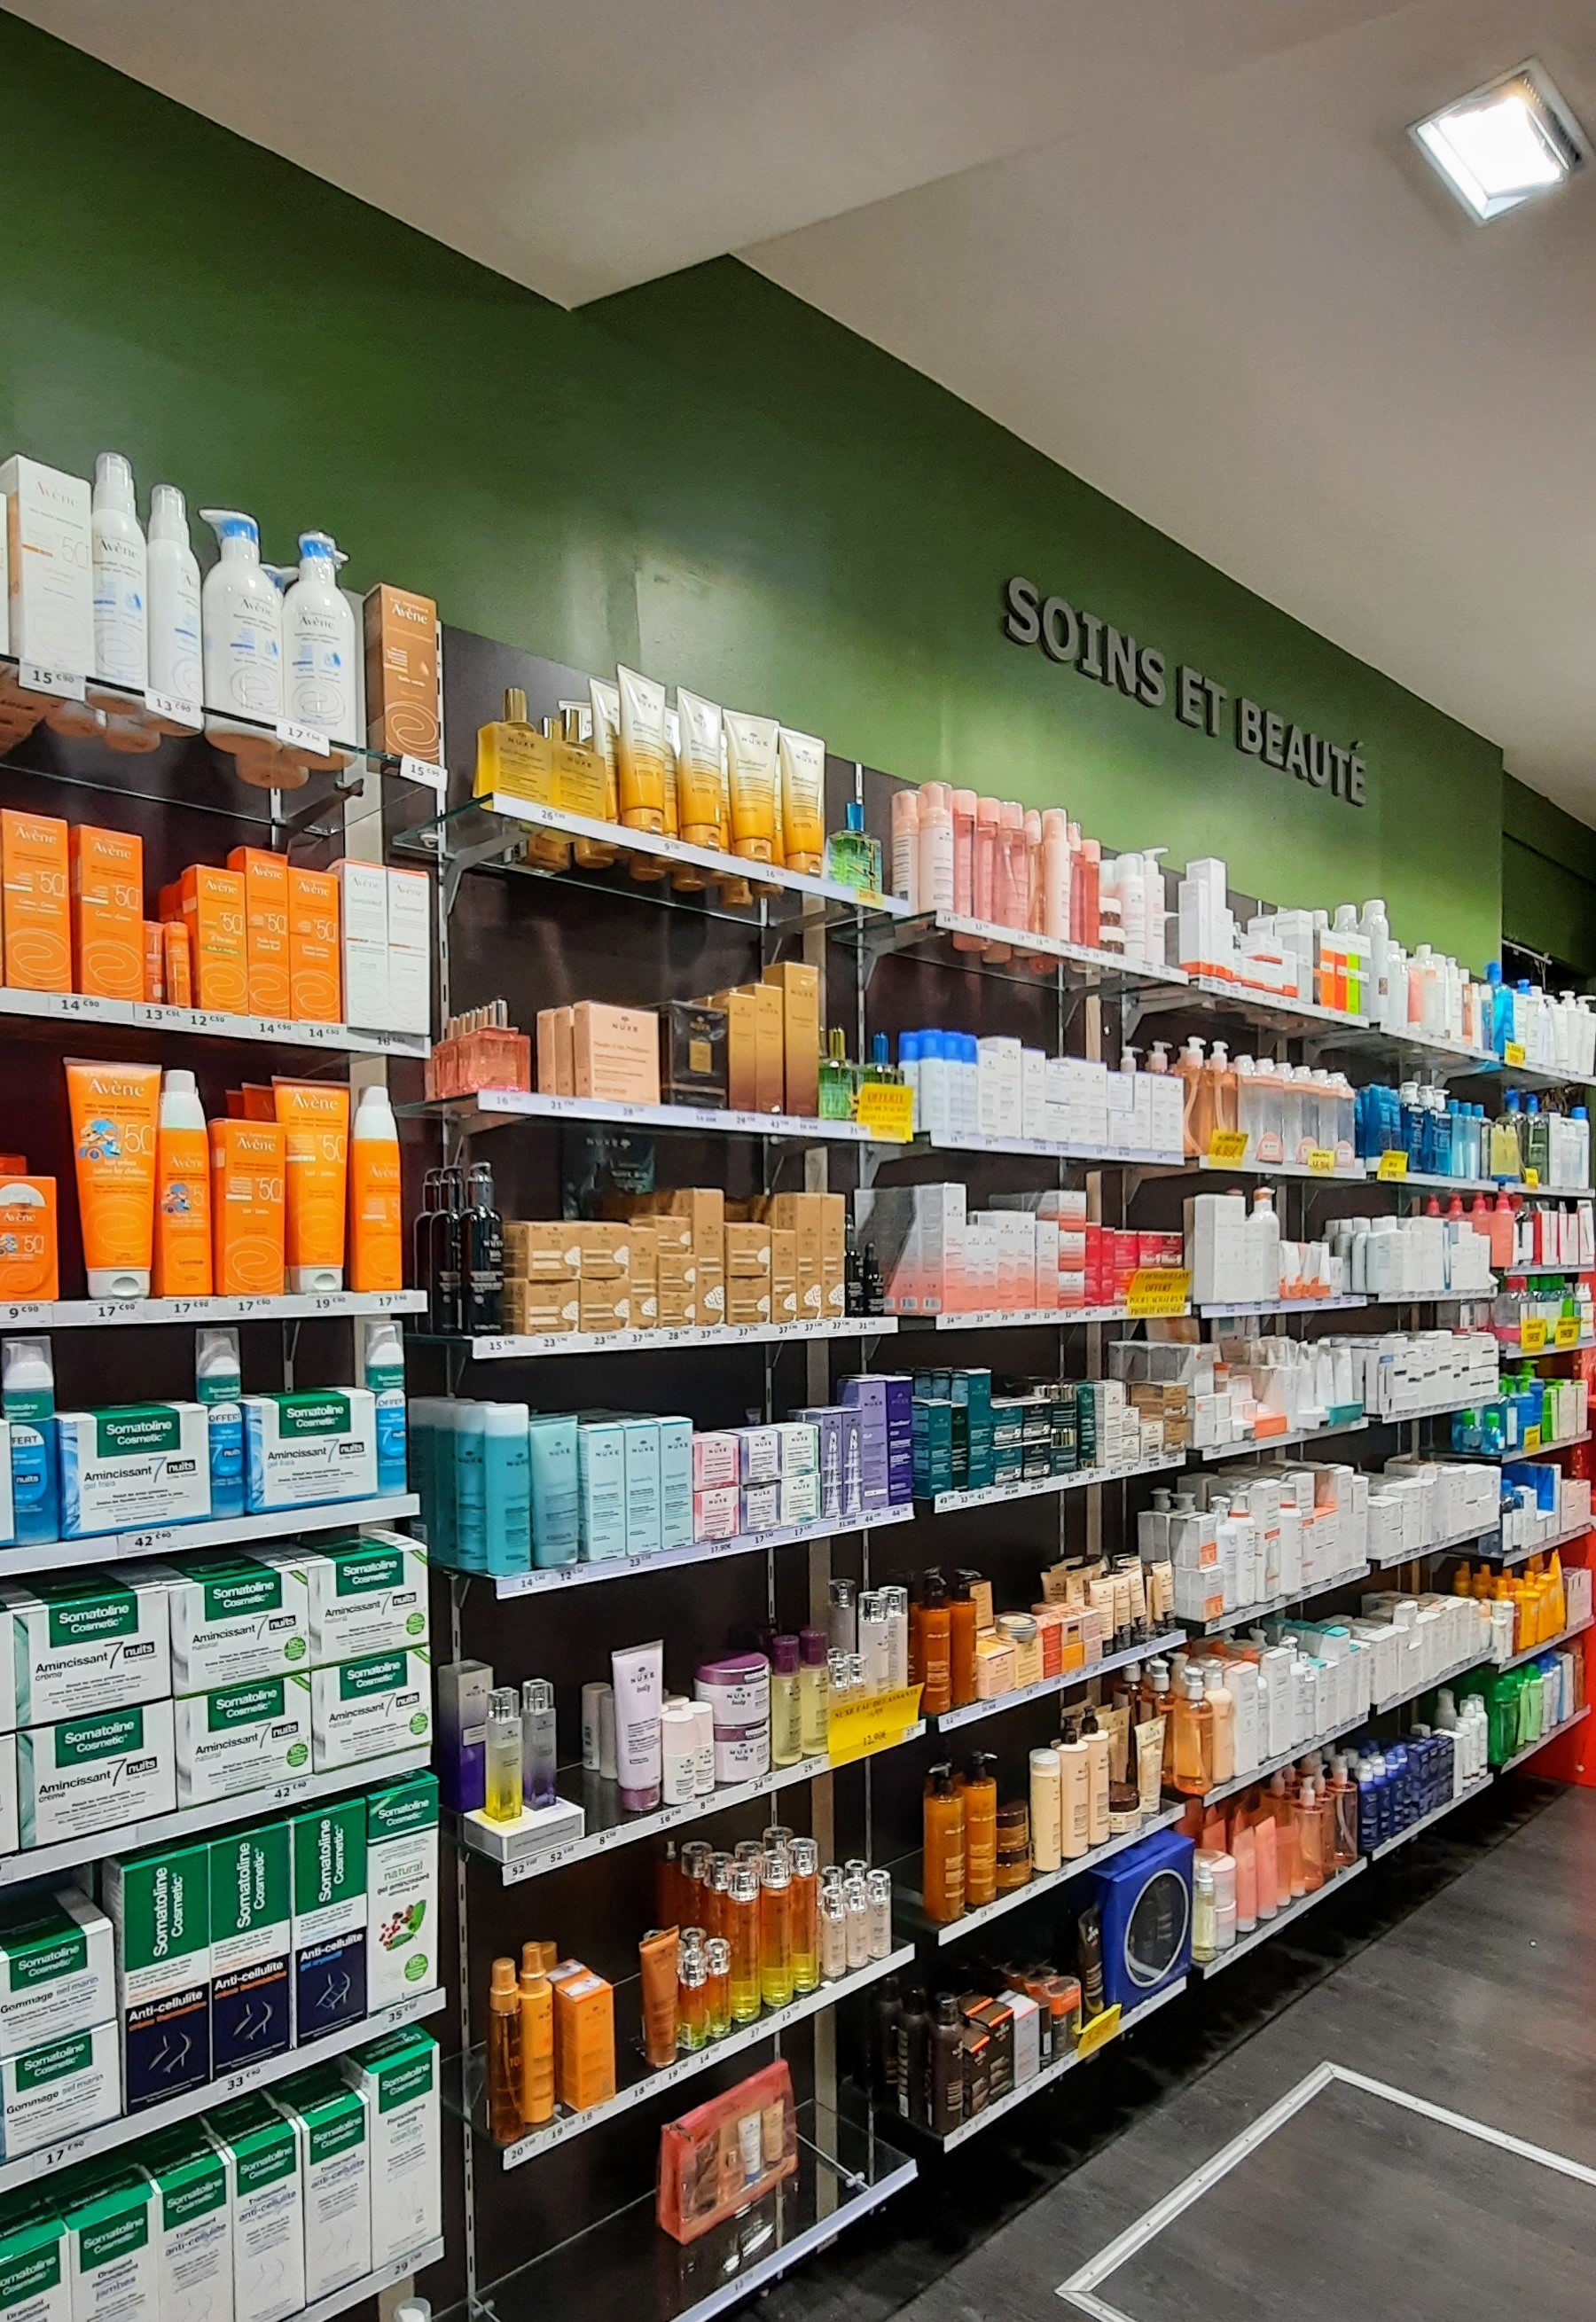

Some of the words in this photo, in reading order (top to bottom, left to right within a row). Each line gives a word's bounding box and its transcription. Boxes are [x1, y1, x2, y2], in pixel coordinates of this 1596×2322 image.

[35, 481, 79, 507] Avène
[99, 539, 138, 560] Avène
[241, 598, 273, 617] Avène
[392, 603, 427, 624] Avène
[300, 616, 334, 629] Avène
[33, 670, 52, 684] 15
[1003, 575, 1167, 708] SOINS
[1176, 666, 1227, 737] ET
[1237, 697, 1366, 807] BEAUTÉ
[156, 699, 172, 711] 13
[288, 727, 302, 739] 17
[508, 736, 535, 749] NUXE
[741, 736, 769, 747] NUXE
[567, 755, 592, 769] NUXE
[795, 754, 818, 766] NUXE
[411, 764, 424, 777] 15
[542, 810, 552, 820] 26
[16, 826, 57, 844] Avène
[95, 842, 131, 860] Avène
[253, 864, 283, 880] Avène
[206, 879, 238, 895] Avène
[298, 880, 330, 897] Avène
[62, 1000, 80, 1011] 14
[146, 1010, 162, 1020] 13
[192, 1015, 207, 1026] 12
[260, 1023, 274, 1033] 14
[309, 1028, 324, 1038] 14
[613, 1023, 638, 1033] NUXE
[89, 1077, 145, 1098] Avène
[293, 1092, 339, 1110] Avène
[238, 1138, 276, 1152] Avène
[172, 1156, 203, 1169] Avène
[4, 1211, 35, 1223] Avène
[174, 1303, 190, 1314] 17
[239, 1302, 253, 1310] 17
[317, 1299, 330, 1309] 19
[379, 1297, 392, 1306] 17
[9, 1307, 18, 1318] 9
[98, 1307, 115, 1317] 17
[544, 1339, 555, 1348] 23
[594, 1336, 605, 1345] 23
[286, 1405, 344, 1419] Somatoline
[106, 1420, 172, 1435] Somatoline
[295, 1417, 336, 1428] Cosmetic
[117, 1434, 163, 1446] Cosmetic
[268, 1447, 326, 1460] Amincissant
[323, 1439, 340, 1463] 7
[340, 1442, 364, 1453] nuits
[549, 1447, 571, 1456] NUXE
[595, 1449, 619, 1458] NUXE
[84, 1466, 152, 1482] Amincissant
[148, 1457, 168, 1483] 7
[168, 1460, 195, 1474] nuits
[135, 1537, 153, 1546] 42
[343, 1560, 397, 1576] Somatoline
[351, 1572, 390, 1585] Cosmetic
[560, 1572, 571, 1581] 12
[213, 1580, 275, 1599] Somatoline
[223, 1594, 266, 1608] Cosmetic
[325, 1601, 381, 1618] Amincissant
[378, 1591, 392, 1615] 7
[393, 1592, 416, 1605] nuits
[59, 1605, 129, 1624] Somatoline
[71, 1619, 120, 1633] Cosmetic
[192, 1624, 255, 1644] Amincissant
[252, 1614, 270, 1640] 7
[270, 1616, 295, 1630] nuits
[35, 1653, 108, 1674] Amincissant
[105, 1642, 124, 1669] 7
[124, 1643, 153, 1657] nuits
[347, 1661, 401, 1680] Somatoline
[630, 1671, 654, 1684] NUXE
[356, 1673, 393, 1687] Cosmetic
[216, 1688, 277, 1709] Somatoline
[226, 1702, 269, 1718] Cosmetic
[329, 1704, 385, 1723] Amincissant
[381, 1693, 396, 1717] 7
[396, 1693, 419, 1707] nuits
[856, 1704, 869, 1713] EAU
[65, 1722, 135, 1745] Somatoline
[195, 1732, 258, 1755] Amincissant
[255, 1723, 271, 1748] 7
[272, 1722, 298, 1738] nuits
[76, 1735, 124, 1754] Cosmetic
[39, 1771, 111, 1794] Amincissant
[107, 1759, 128, 1787] 7
[128, 1757, 156, 1774] nuits
[274, 1787, 290, 1798] 42
[379, 1799, 429, 1819] Somatoline
[387, 1811, 421, 1827] Cosmetic
[599, 1836, 605, 1845] 8
[319, 1819, 332, 1903] Somatoline
[333, 1827, 344, 1885] Cosmetic
[550, 1852, 562, 1863] 52
[384, 1861, 423, 1880] natural
[512, 1865, 524, 1876] 52
[237, 1842, 251, 1929] Somatoline
[254, 1850, 265, 1911] Cosmetic
[153, 1867, 168, 1958] Somatoline
[171, 1876, 183, 1938] Cosmetic
[300, 1932, 364, 1962] Anti-cellulite
[18, 1945, 80, 1971] Somatoline
[28, 1958, 71, 1977] Cosmetic
[215, 1960, 284, 1991] Anti-cellulite
[1, 1991, 53, 2014] Gommage
[129, 1990, 203, 2022] Anti-cellulite
[388, 2011, 403, 2022] 35
[24, 2043, 85, 2071] Somatoline
[509, 2056, 520, 2068] 10
[34, 2057, 76, 2076] Cosmetic
[227, 2077, 243, 2091] 33
[381, 2063, 431, 2091] Somatoline
[389, 2076, 425, 2096] Cosmetic
[6, 2091, 59, 2115] Gommage
[313, 2115, 362, 2144] Somatoline
[552, 2128, 563, 2140] 19
[320, 2130, 355, 2149] Cosmetic
[46, 2150, 64, 2165] 17
[240, 2146, 293, 2174] Somatoline
[511, 2147, 524, 2160] 20
[248, 2158, 287, 2179] Cosmetic
[167, 2177, 223, 2209] Somatoline
[176, 2192, 215, 2213] Cosmetic
[83, 2216, 145, 2249] Somatoline
[94, 2231, 137, 2254] Cosmetic
[395, 2262, 408, 2275] 29
